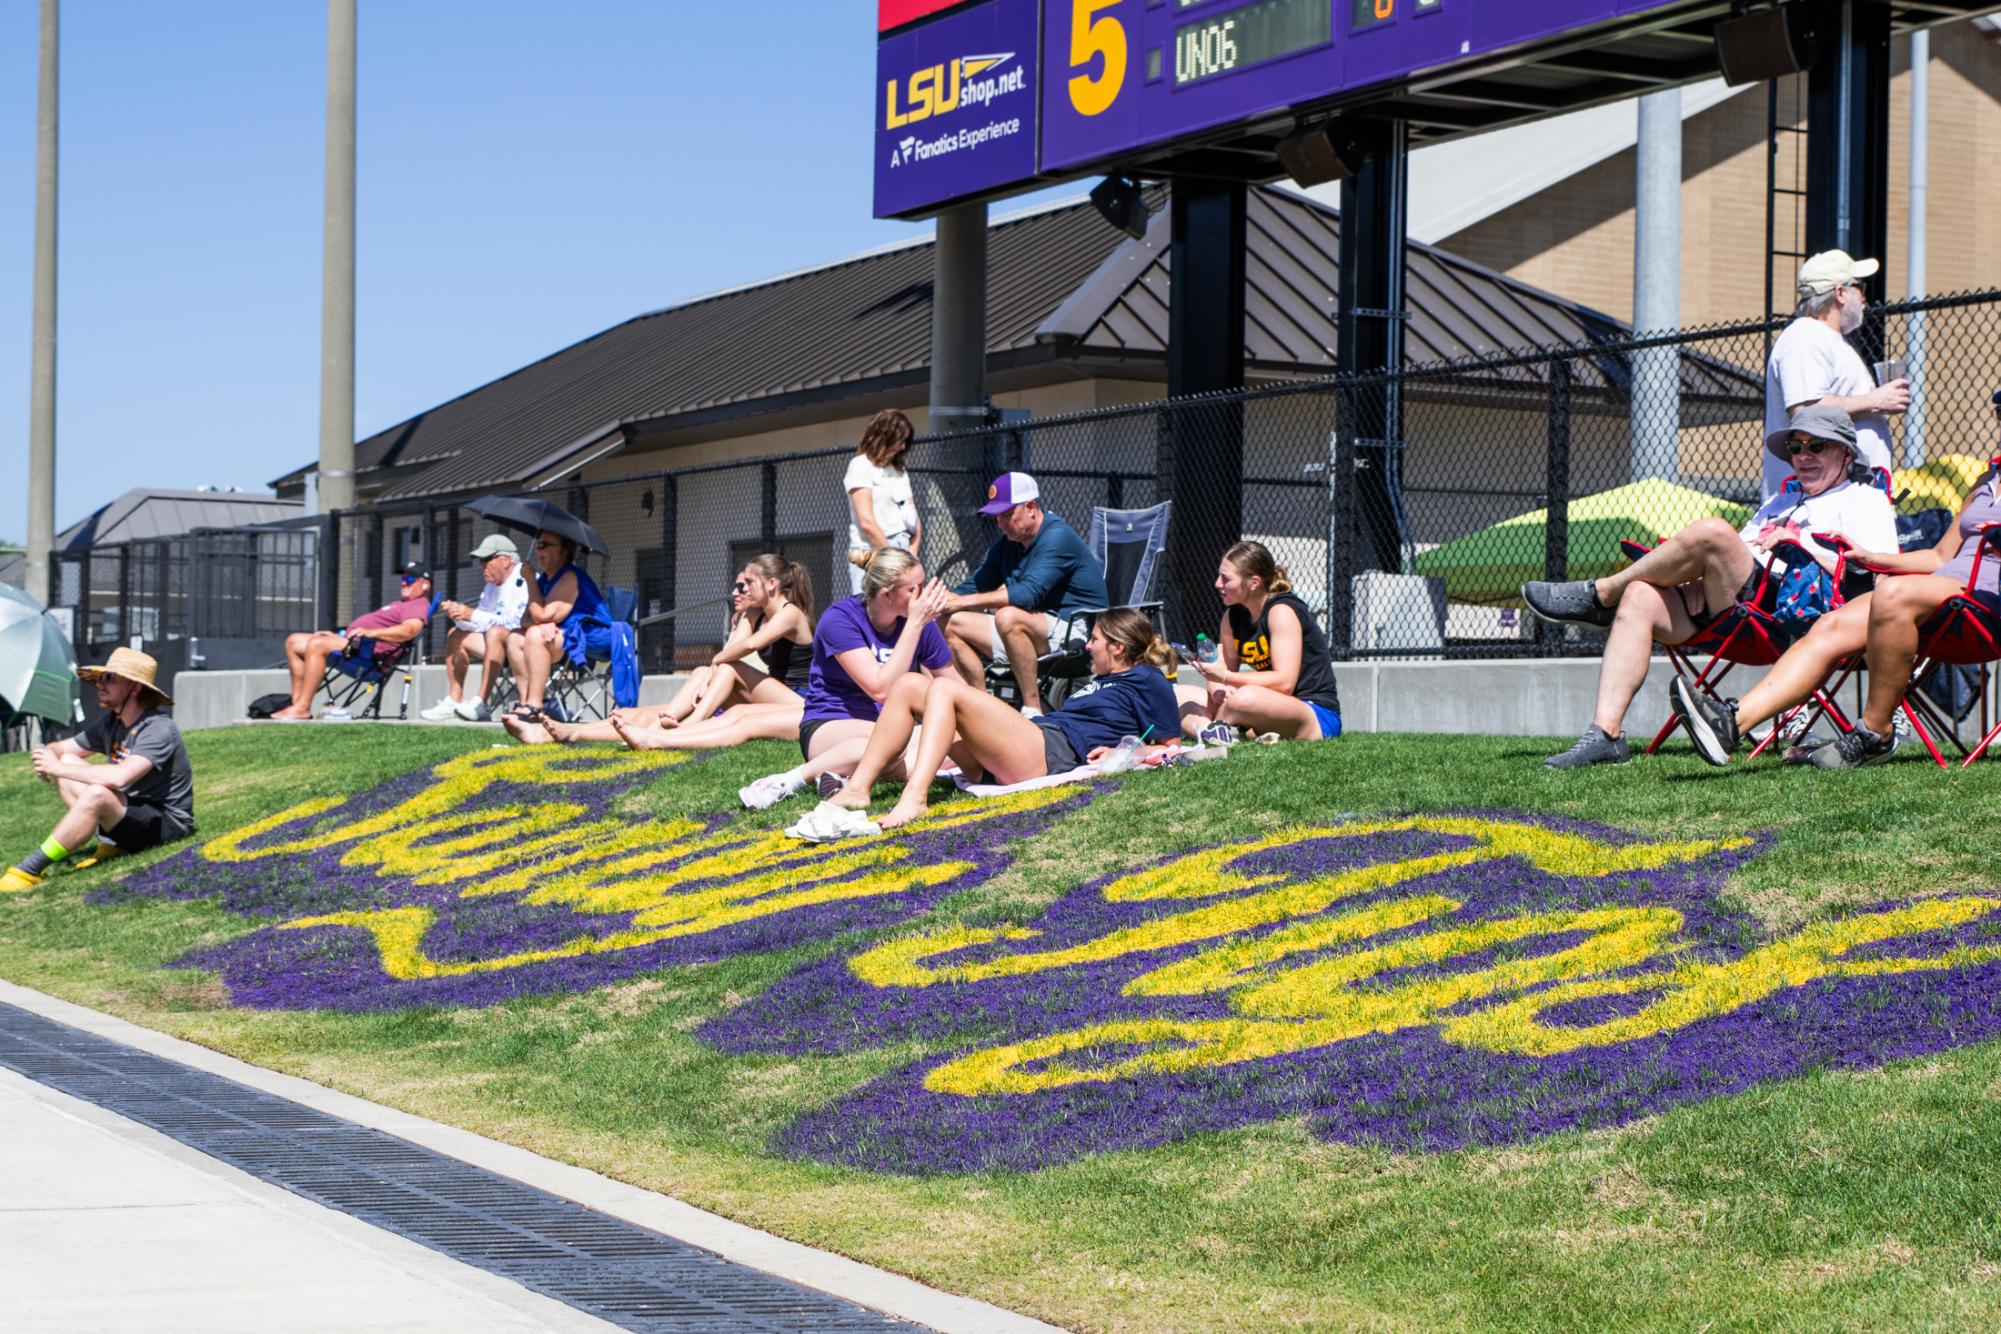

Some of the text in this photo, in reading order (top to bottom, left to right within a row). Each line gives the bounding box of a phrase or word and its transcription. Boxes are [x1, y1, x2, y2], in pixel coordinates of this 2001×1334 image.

[886, 58, 961, 131] LSU
[1068, 0, 1127, 117] 5
[914, 133, 958, 161] Fanatics
[959, 117, 1020, 150] Experience
